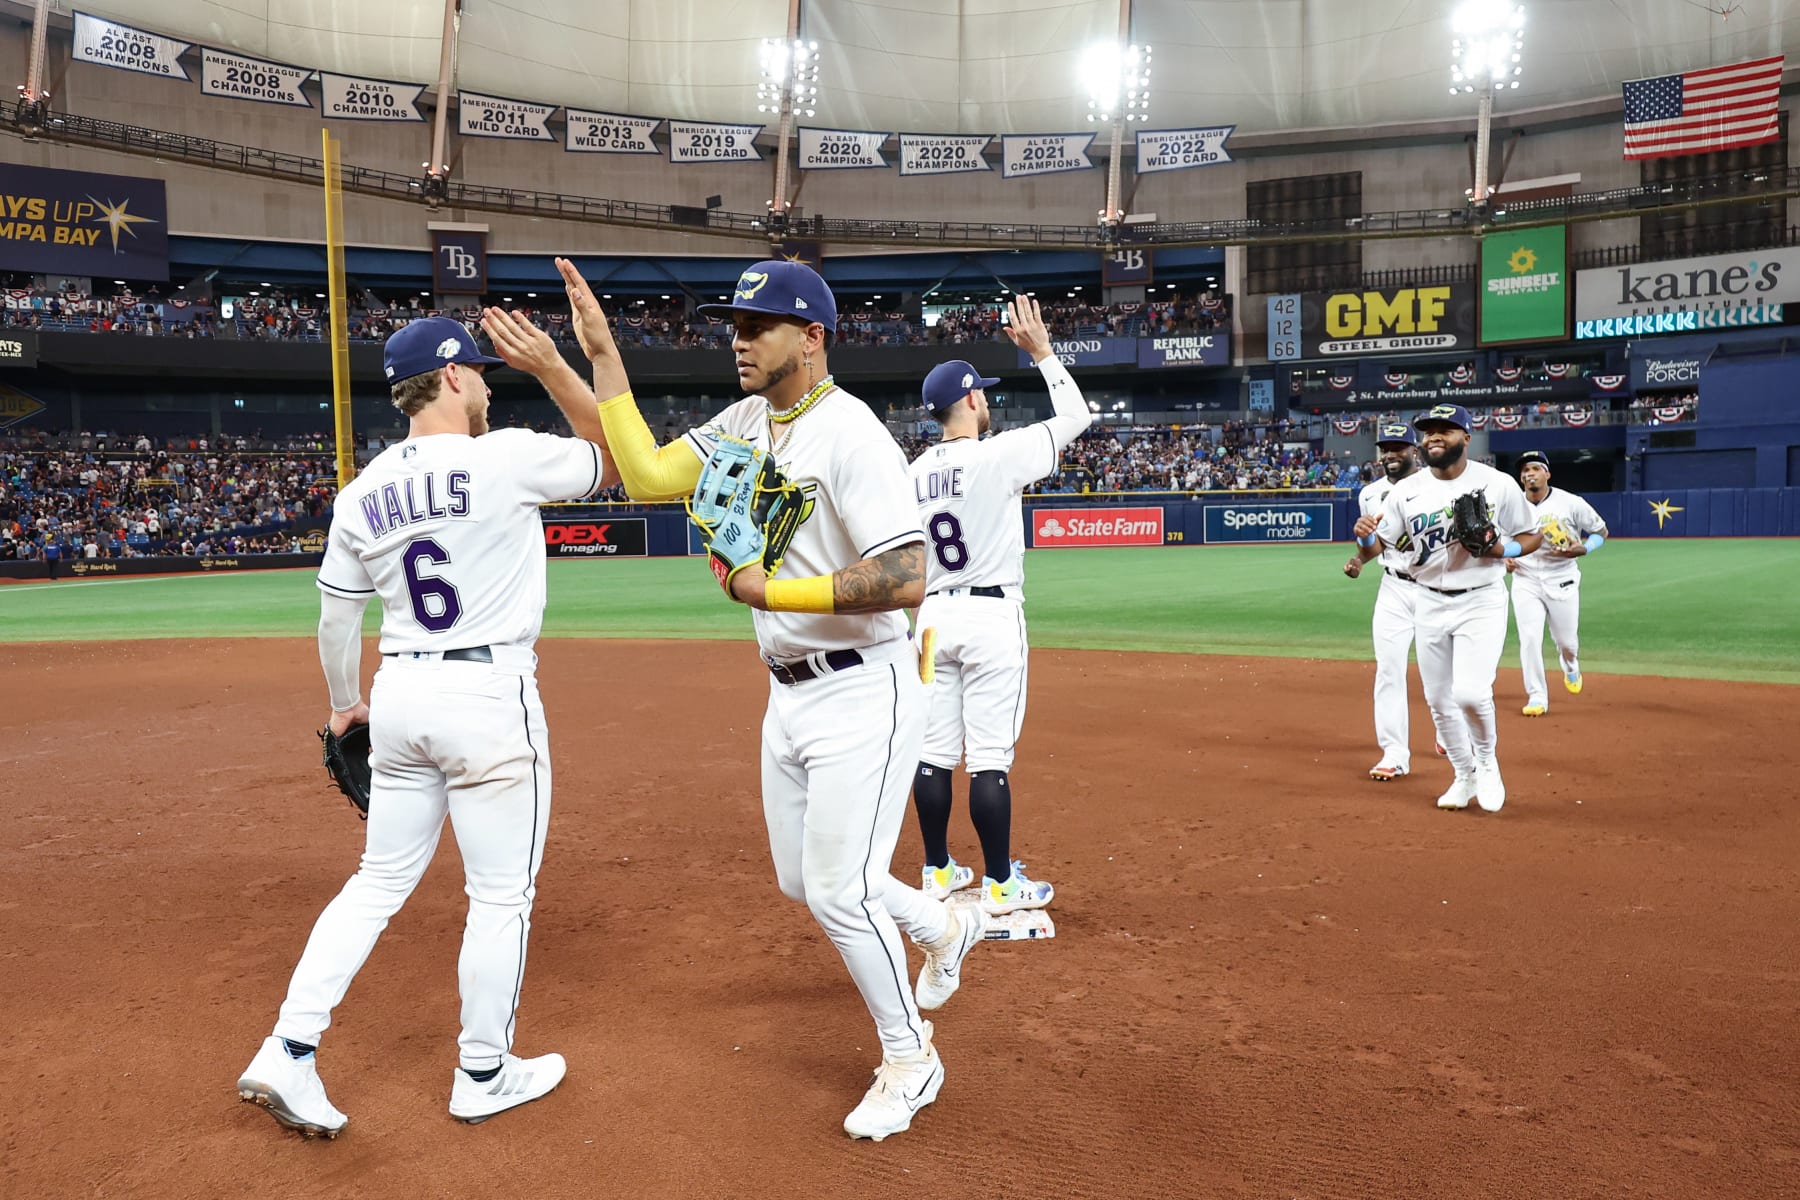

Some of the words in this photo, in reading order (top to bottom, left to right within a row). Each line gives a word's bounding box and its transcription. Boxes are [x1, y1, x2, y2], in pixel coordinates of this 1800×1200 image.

[106, 28, 118, 37] AL
[124, 30, 152, 44] EAST
[100, 36, 156, 60] 2008
[84, 47, 170, 73] CHAMPIONS
[205, 56, 258, 71] AMERICAN
[262, 65, 301, 78] LEAGUE
[226, 67, 281, 89] 2008
[211, 79, 295, 102] CHAMPIONS
[350, 83, 362, 91] AL
[365, 84, 391, 93] EAST
[345, 91, 395, 107] 2010
[462, 98, 508, 111] AMERICAN
[512, 105, 546, 115] LEAGUE
[333, 103, 408, 118] CHAMPIONS
[483, 109, 526, 126] 2011
[468, 120, 500, 133] WILD
[504, 126, 540, 137] CARD
[569, 115, 614, 125] AMERICAN
[618, 119, 652, 128] LEAGUE
[588, 124, 632, 140] 2013
[672, 127, 717, 135] AMERICAN
[836, 135, 858, 143] EAST
[1140, 134, 1186, 144] AMERICAN
[1189, 130, 1225, 140] LEAGUE
[575, 136, 607, 148] WILD
[611, 140, 646, 151] CARD
[691, 134, 735, 148] 2019
[1027, 139, 1039, 147] AL
[1042, 137, 1066, 146] EAST
[1158, 140, 1206, 156] 2022
[678, 148, 710, 158] WILD
[714, 148, 748, 158] CARD
[819, 143, 862, 156] 2020
[919, 146, 966, 160] 2020
[1023, 146, 1065, 161] 2021
[807, 155, 874, 165] CHAMPIONS
[907, 159, 978, 169] CHAMPIONS
[1011, 158, 1081, 172] CHAMPIONS
[1147, 155, 1178, 167] WILD
[1183, 152, 1219, 164] CARD
[53, 200, 95, 224] UP
[53, 226, 101, 246] BAY
[440, 244, 478, 279] TB
[1487, 272, 1559, 292] SUNBELT
[1616, 261, 1782, 305] kane's
[1274, 298, 1295, 315] 42
[1326, 286, 1451, 338] GMF
[1632, 297, 1764, 316] FURNITURE
[1276, 320, 1293, 336] 12
[1049, 340, 1101, 353] YMOND
[1153, 336, 1214, 351] REPUBLIC
[1274, 341, 1295, 357] 66
[1328, 341, 1382, 352] STEEL
[1389, 336, 1447, 348] GROUP
[1165, 347, 1202, 361] BANK
[1646, 366, 1700, 384] PORCH
[1360, 391, 1375, 400] St.
[1377, 388, 1438, 400] Petersburg
[1440, 386, 1493, 396] Welcomes
[1495, 384, 1520, 394] You!
[914, 466, 964, 505] LOWE
[359, 470, 471, 540] WALLS
[1223, 509, 1307, 530] Spectrum
[545, 524, 612, 544] DEX
[1167, 531, 1184, 541] 378
[1266, 525, 1307, 539] mobile
[927, 510, 972, 573] 8
[400, 536, 464, 635] 6
